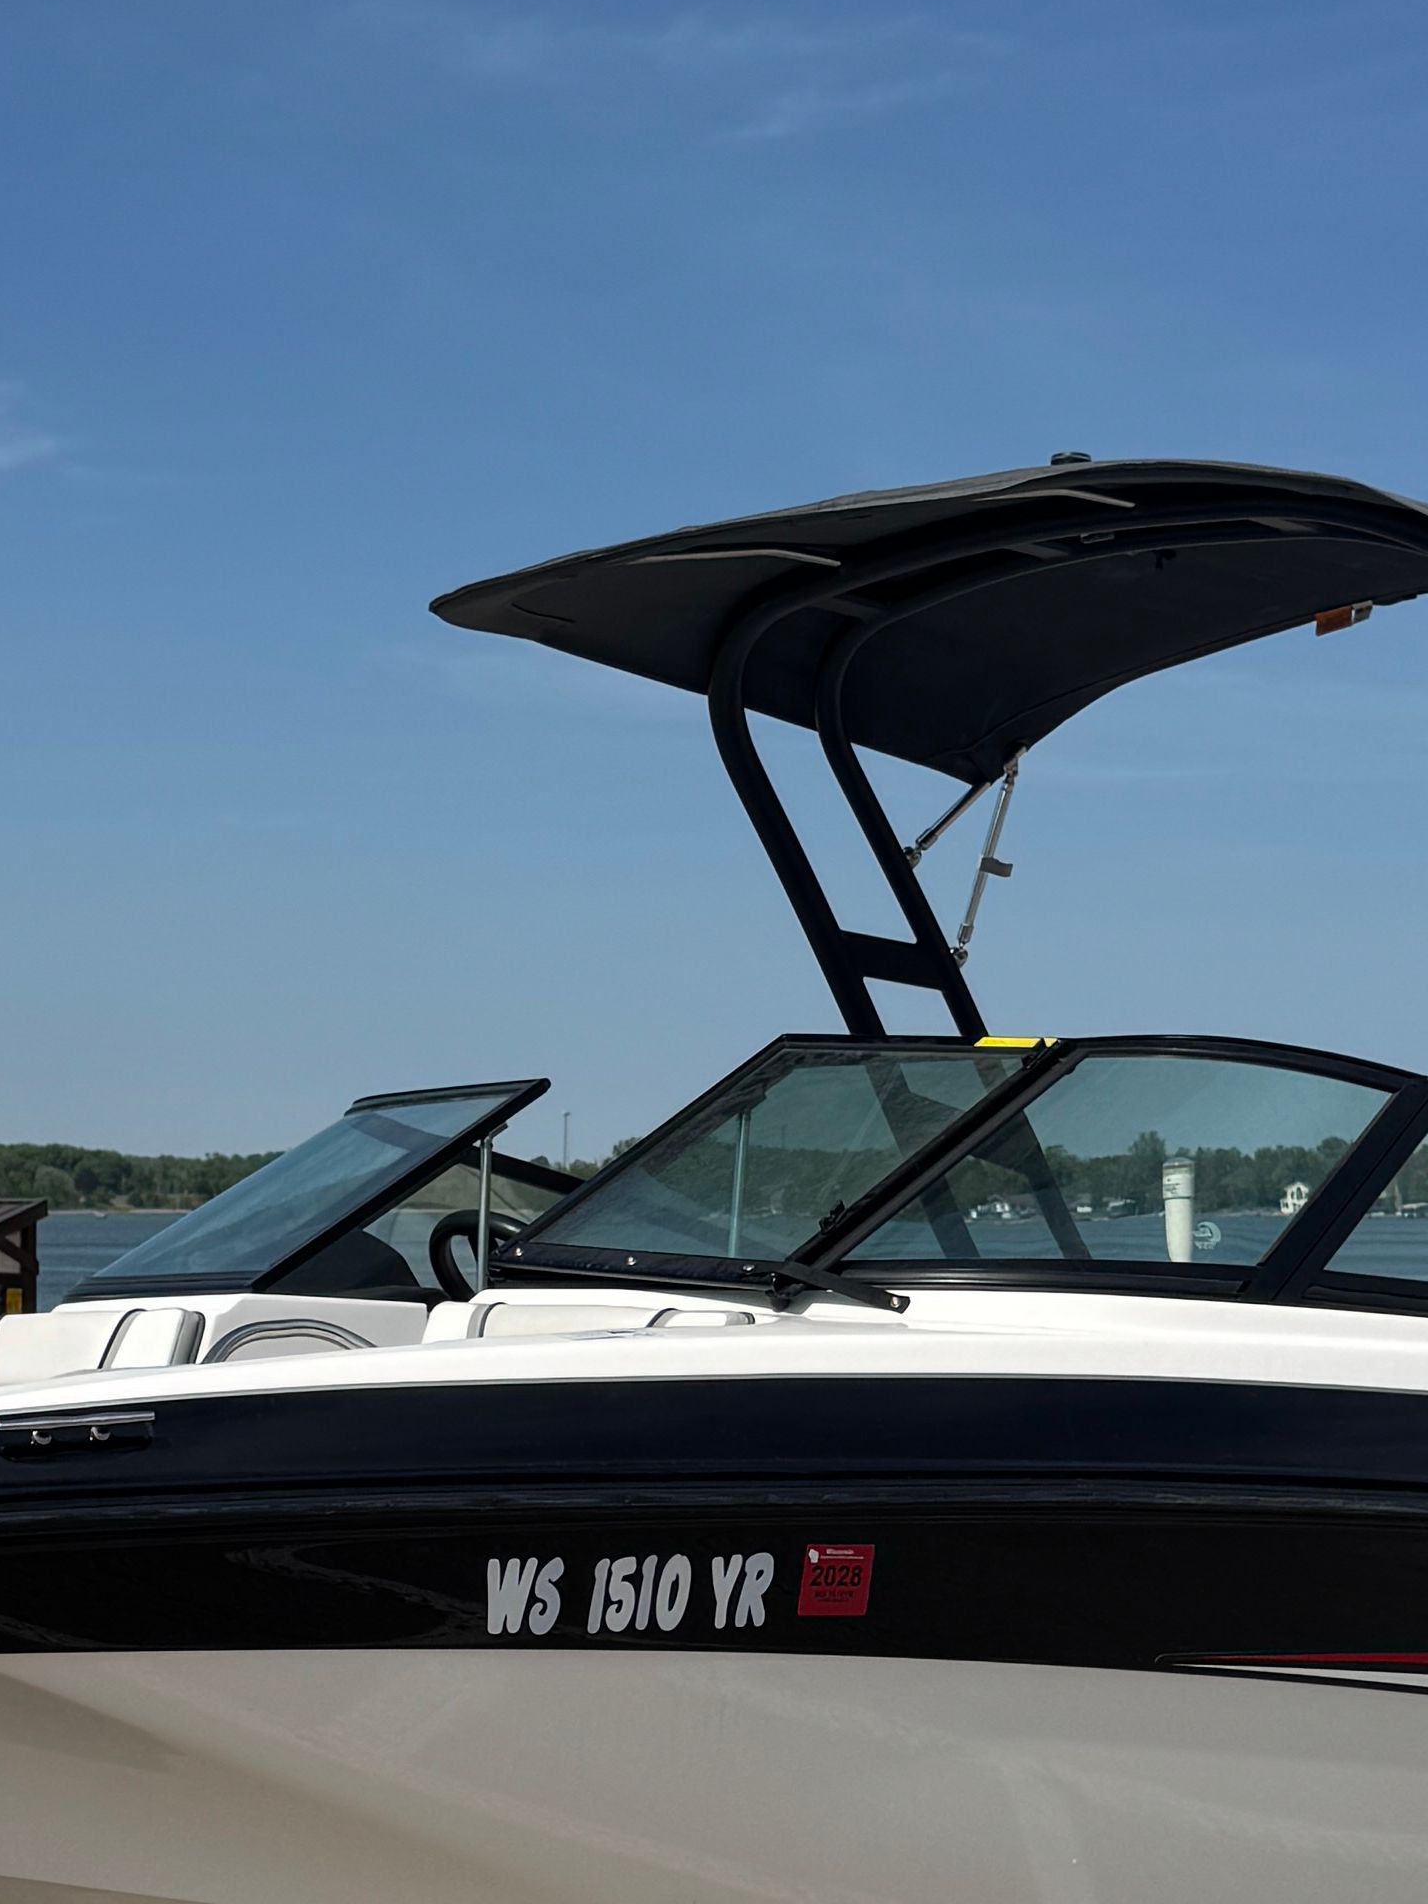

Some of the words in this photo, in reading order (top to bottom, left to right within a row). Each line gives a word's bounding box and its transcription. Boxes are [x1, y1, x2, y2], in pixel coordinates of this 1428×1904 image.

[486, 1557, 565, 1635] WS
[586, 1554, 692, 1634] 1510
[712, 1552, 774, 1629] YR
[809, 1564, 863, 1587] 2028
